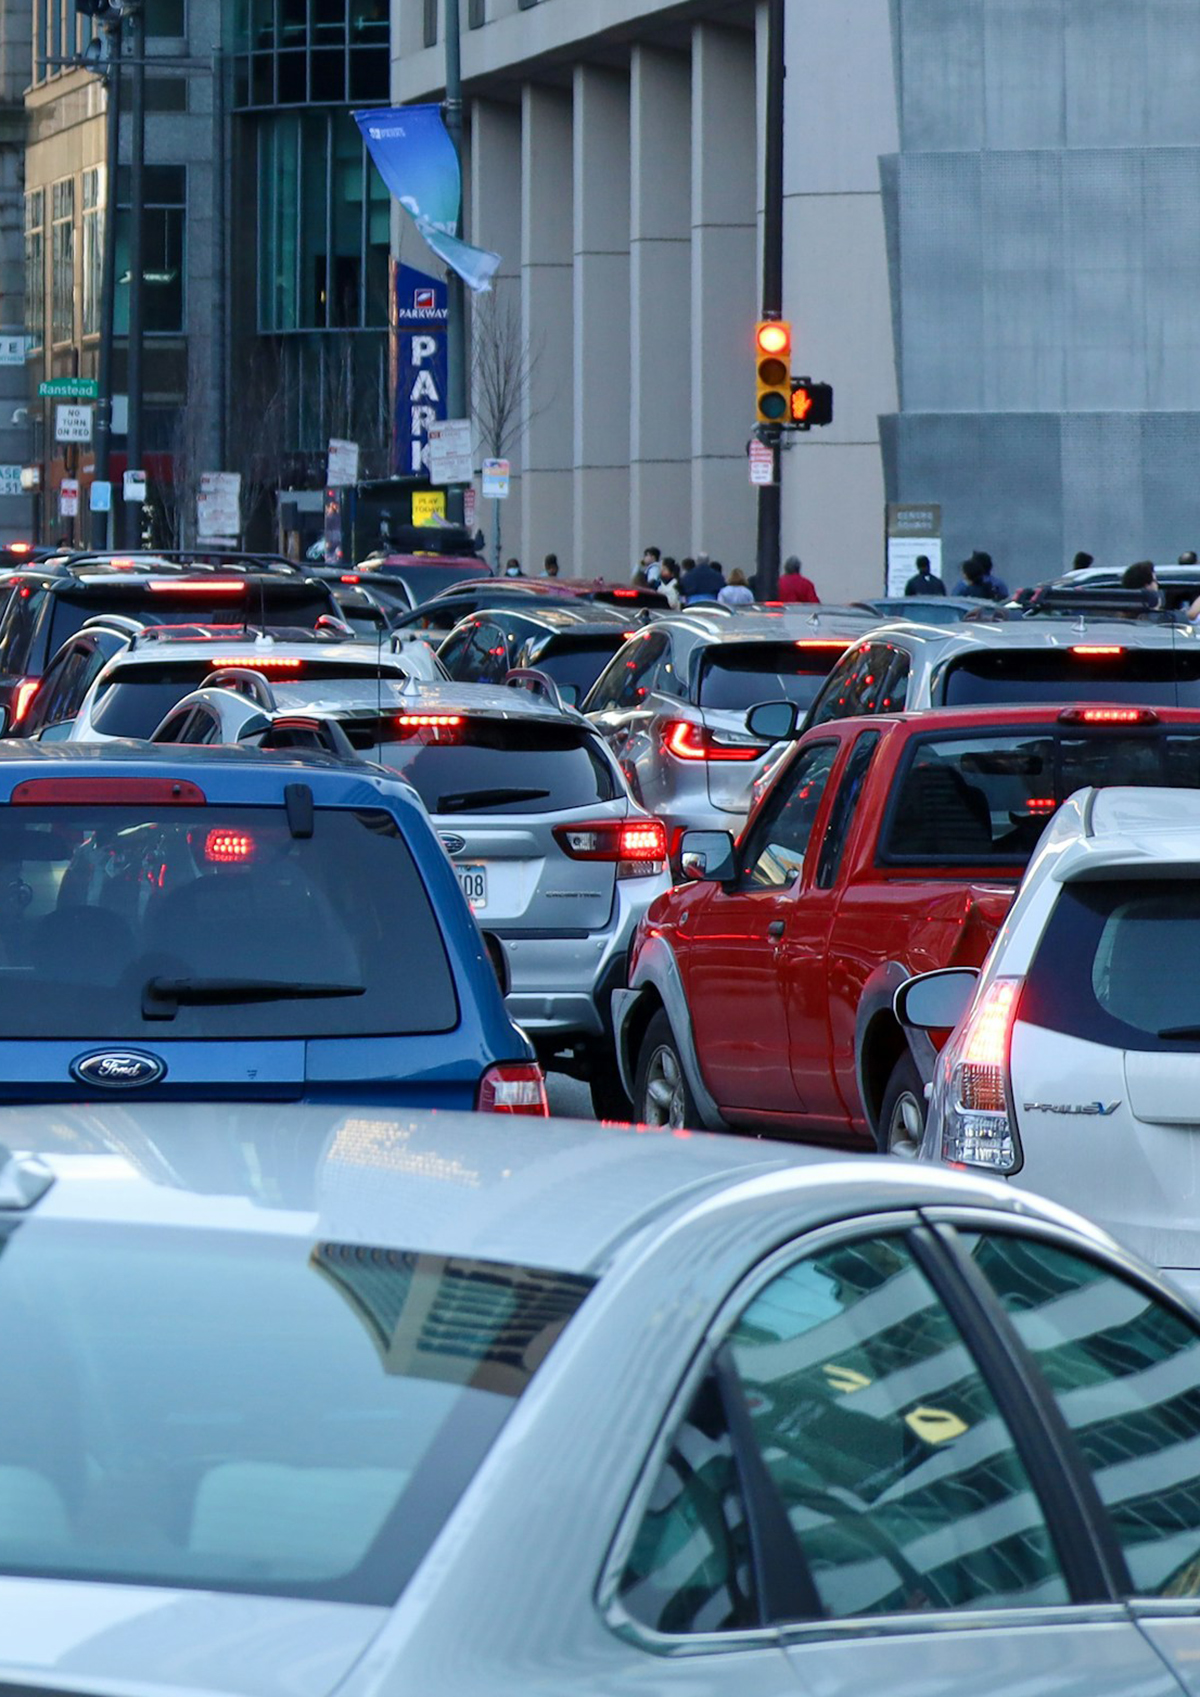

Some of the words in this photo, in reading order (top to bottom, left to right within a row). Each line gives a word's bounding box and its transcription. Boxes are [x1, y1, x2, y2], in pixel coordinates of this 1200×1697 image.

[400, 309, 448, 319] PARKWAY
[39, 382, 93, 396] Ranstead
[410, 336, 439, 471] PARK
[67, 409, 80, 417] NO
[62, 419, 87, 427] TURN
[57, 428, 70, 436] ON
[72, 429, 90, 437] RED
[98, 1058, 141, 1076] Ford
